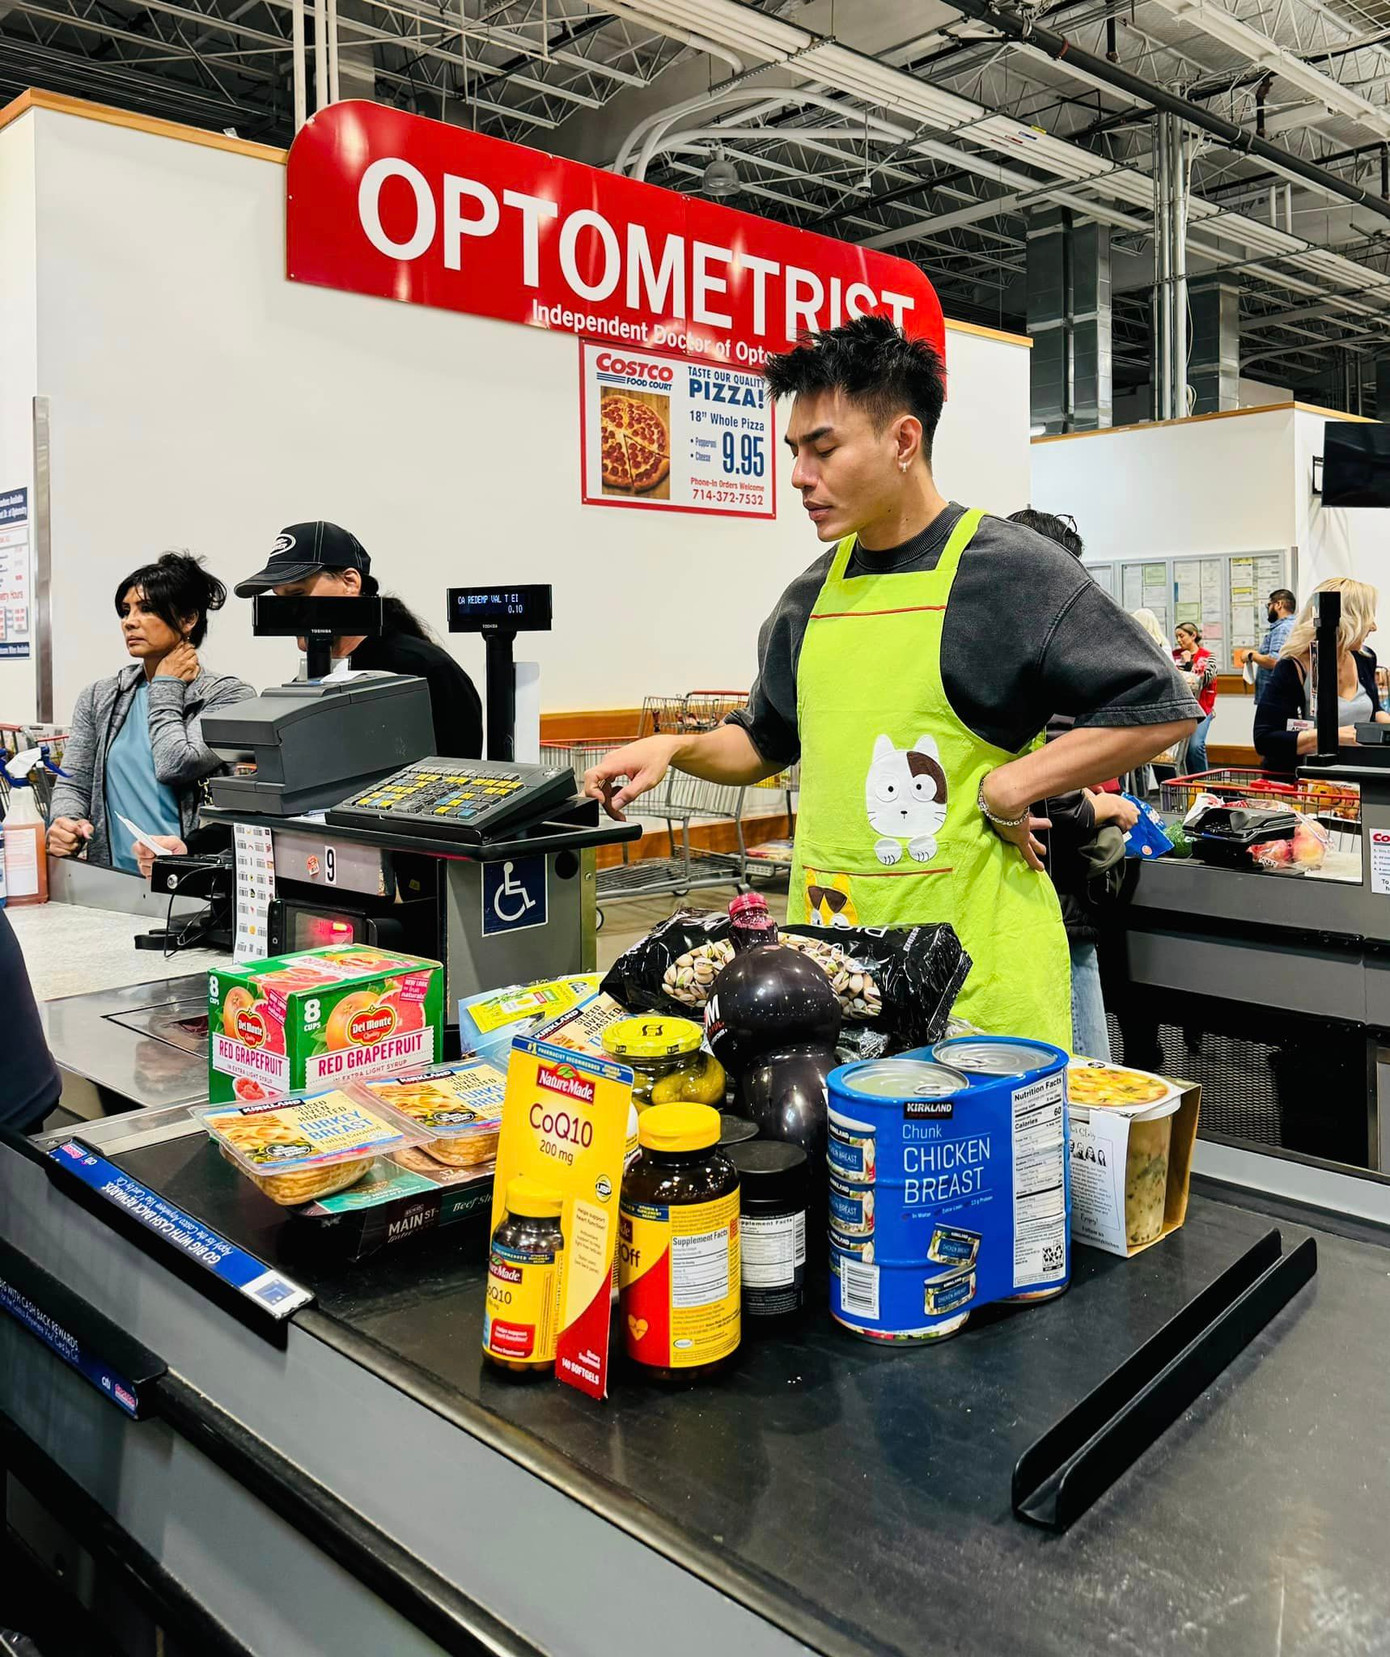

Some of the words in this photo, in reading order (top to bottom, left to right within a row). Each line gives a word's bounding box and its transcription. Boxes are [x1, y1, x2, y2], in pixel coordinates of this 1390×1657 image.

[358, 157, 914, 346] OPTOMETRIST
[532, 298, 649, 342] Independent
[654, 324, 711, 353] Doctor
[715, 338, 732, 357] of
[736, 341, 774, 366] Opto
[596, 352, 674, 382] COSTCO
[626, 377, 648, 387] FOOD
[648, 380, 672, 391] COURT
[688, 366, 711, 379] TASTE
[713, 371, 731, 383] OUR
[733, 375, 765, 388] QUALITY
[689, 378, 764, 409] PIZZA!
[710, 413, 739, 428] Whole
[741, 418, 765, 431] Pizza
[722, 431, 765, 477] 9.95
[719, 480, 739, 489] Orders
[739, 482, 765, 492] Welcome
[693, 488, 764, 506] 714-372-7532
[457, 596, 466, 605] CA
[467, 595, 489, 604] REDEMP
[490, 595, 502, 604] VAL
[504, 594, 509, 603] T
[507, 604, 524, 614] 0.10
[1373, 833, 1390, 842] Co
[326, 848, 336, 882] 9
[209, 975, 220, 997] 8
[303, 999, 321, 1023] 8
[575, 1004, 602, 1026] SLICED
[583, 1010, 607, 1028] OVEN
[304, 1021, 322, 1032] CUPS
[352, 1023, 365, 1034] Del
[366, 1016, 392, 1031] Monte
[534, 1009, 579, 1040] KIRKLAND
[584, 1007, 622, 1036] ROASTED
[219, 1040, 233, 1060] RED
[235, 1045, 283, 1077] GRAPEFRUIT
[318, 1055, 343, 1077] RED
[347, 1034, 423, 1069] GRAPEFRUIT
[342, 1071, 364, 1081] EXTRA
[365, 1064, 386, 1076] LIGHT
[386, 1059, 408, 1070] SYRUP
[399, 1070, 452, 1083] KIRKLAND
[445, 1072, 477, 1083] SLICED
[452, 1078, 498, 1092] ROASTED
[454, 1077, 481, 1087] OVEN
[456, 1082, 506, 1100] TURKE
[539, 1069, 568, 1091] Nature
[567, 1082, 593, 1101] Made
[1014, 1085, 1044, 1102] Nutrition
[1045, 1076, 1062, 1090] Facts
[242, 1099, 302, 1113] KIRKLAND
[292, 1100, 327, 1113] SLICED
[300, 1104, 330, 1116] OVEN
[467, 1094, 505, 1108] BREA
[906, 1103, 952, 1112] KIRKLAND
[298, 1106, 347, 1122] ROASTED
[1054, 1106, 1062, 1116] 60
[300, 1110, 362, 1132] TURKEY
[308, 1118, 374, 1140] BREAST
[529, 1103, 593, 1148] CoQ10
[1015, 1118, 1038, 1130] Calories
[902, 1124, 943, 1139] Chunk
[540, 1139, 557, 1154] 200
[558, 1152, 574, 1166] mg
[903, 1137, 991, 1173] CHICKEN
[904, 1166, 985, 1204] BREAST
[134, 1200, 156, 1223] BACK
[452, 1197, 476, 1213] Beef
[150, 1215, 176, 1233] CASH
[179, 1218, 199, 1235] Costco
[388, 1213, 424, 1237] MAIN
[423, 1208, 435, 1221] ST
[168, 1228, 195, 1248] WITH
[196, 1231, 209, 1240] the
[672, 1232, 713, 1247] Supplement
[713, 1229, 728, 1240] Facts
[188, 1240, 205, 1256] BIG
[214, 1241, 233, 1256] Apply
[620, 1242, 640, 1268] Off
[202, 1253, 221, 1265] GO
[487, 1286, 512, 1305] oQ10
[570, 1362, 600, 1385] SOFTGELS
